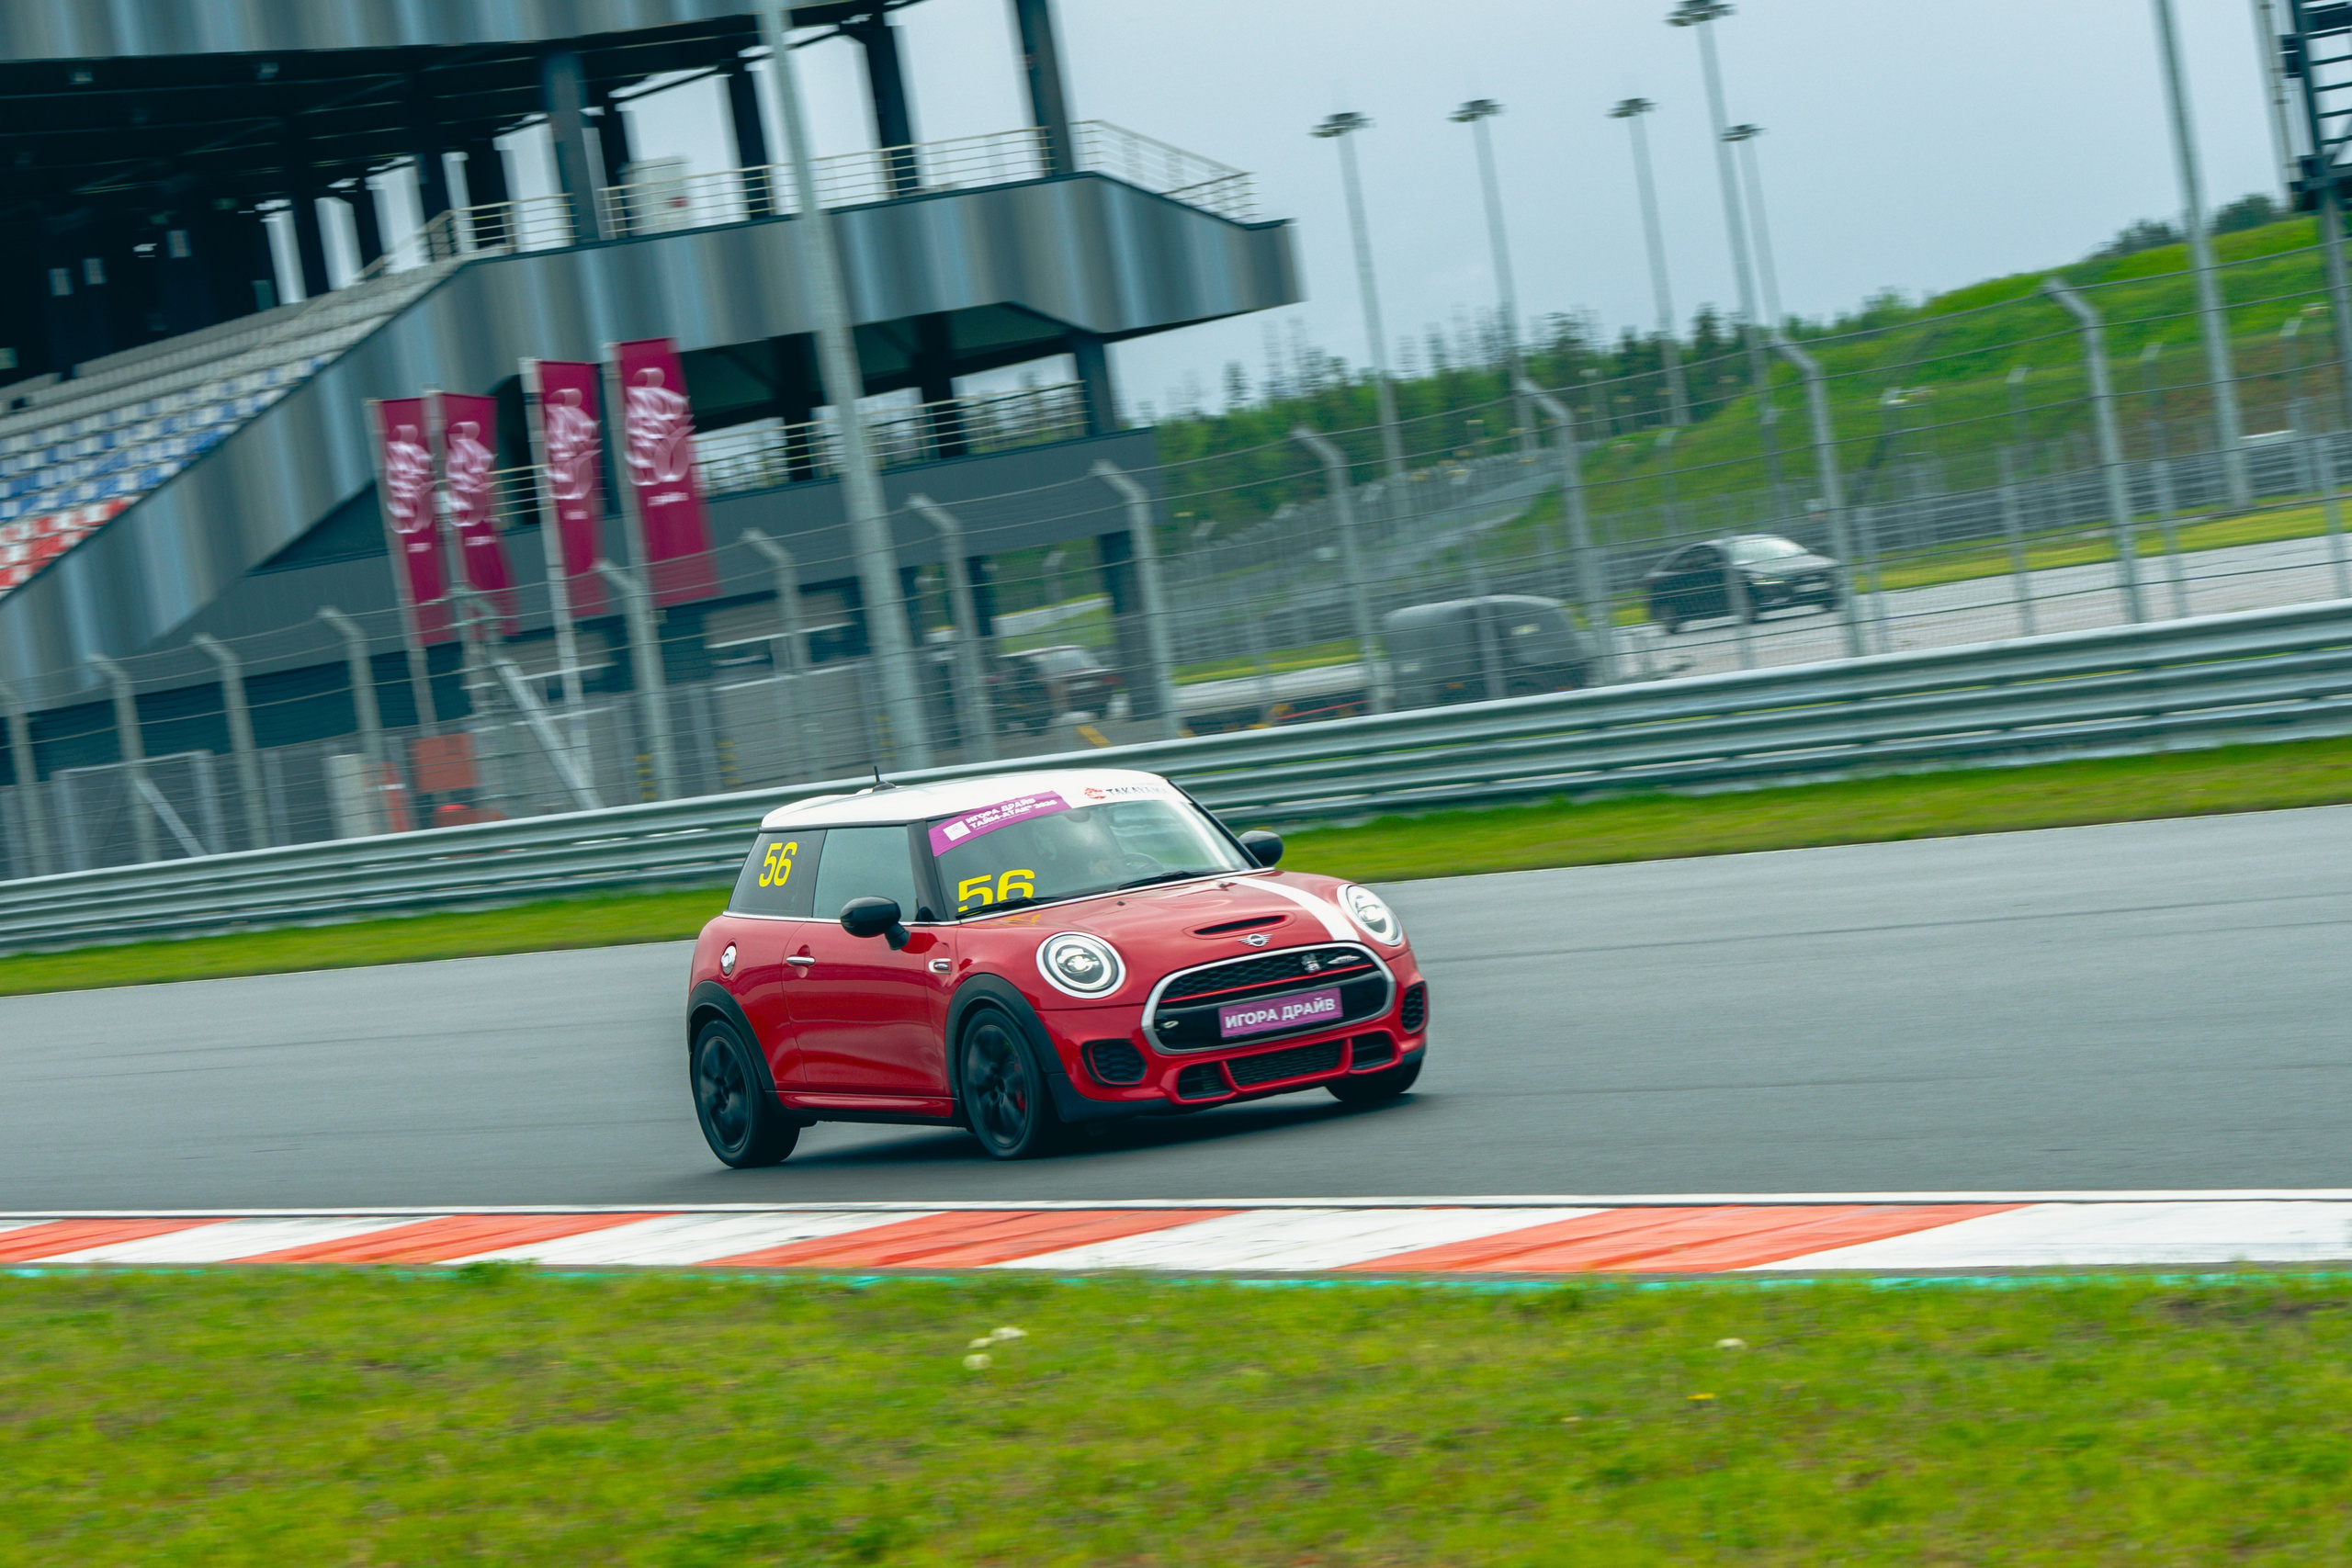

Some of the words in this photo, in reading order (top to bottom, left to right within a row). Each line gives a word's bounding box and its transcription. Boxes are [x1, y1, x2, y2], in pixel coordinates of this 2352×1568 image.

[965, 808, 1001, 824] ИГОРА
[1001, 798, 1036, 812] ДРАЙВ
[759, 841, 797, 887] 56
[957, 869, 1035, 913] 56
[1225, 1009, 1279, 1029] ИГОРА
[1281, 997, 1336, 1021] ДРАЙВ
